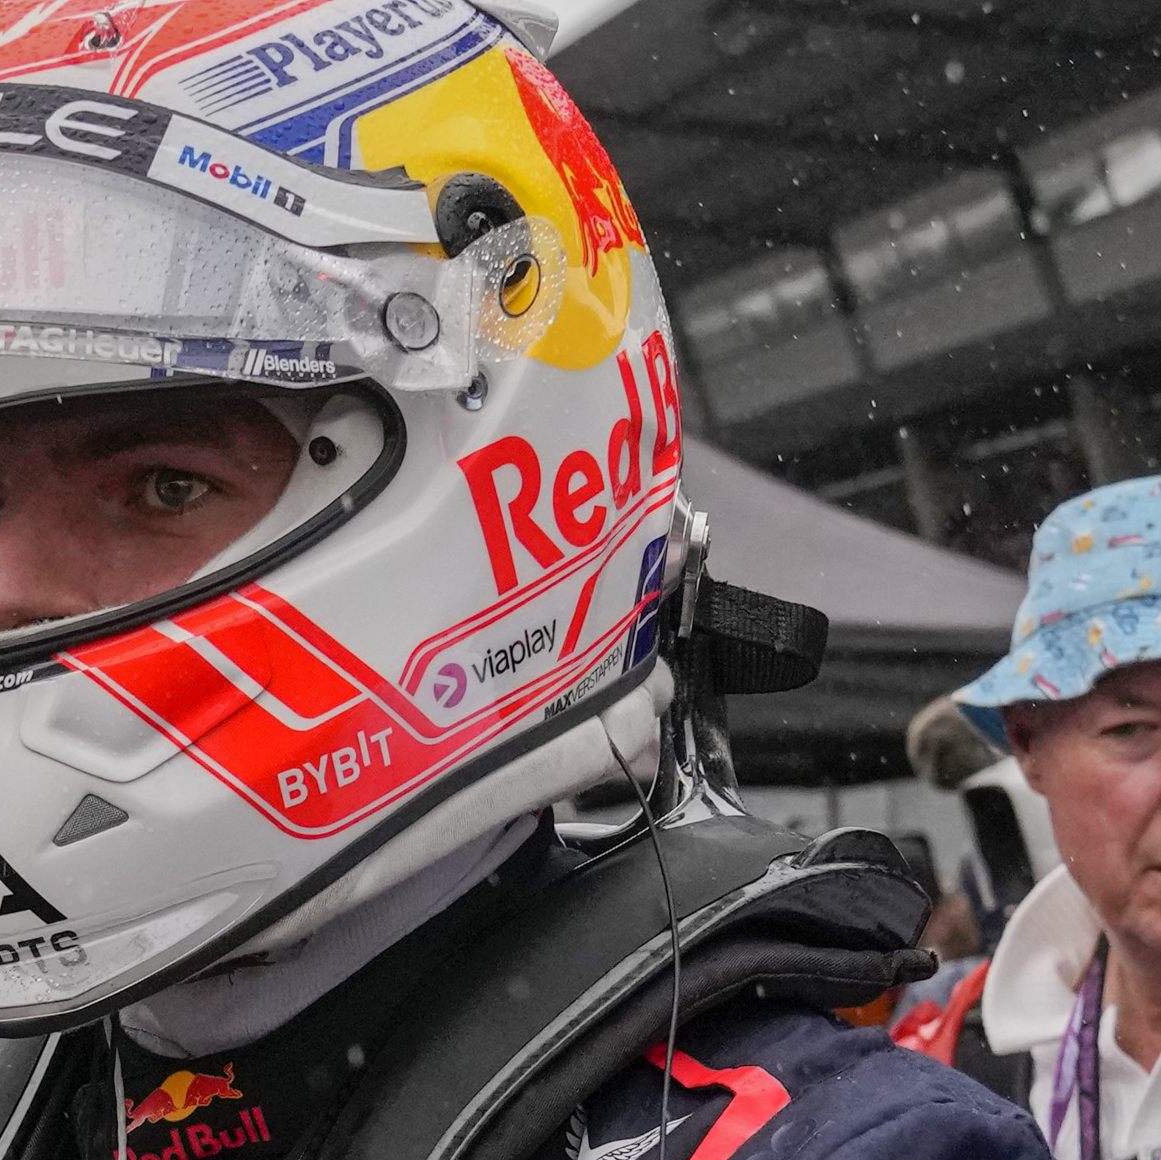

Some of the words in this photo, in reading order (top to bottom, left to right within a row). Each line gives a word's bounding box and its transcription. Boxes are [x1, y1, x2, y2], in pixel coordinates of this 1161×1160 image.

[178, 145, 272, 199] Mobil
[263, 354, 336, 374] Blenders
[457, 350, 643, 596] Red
[472, 619, 557, 684] viaplay
[277, 727, 394, 809] BYBIT
[185, 1105, 271, 1159] Bull
